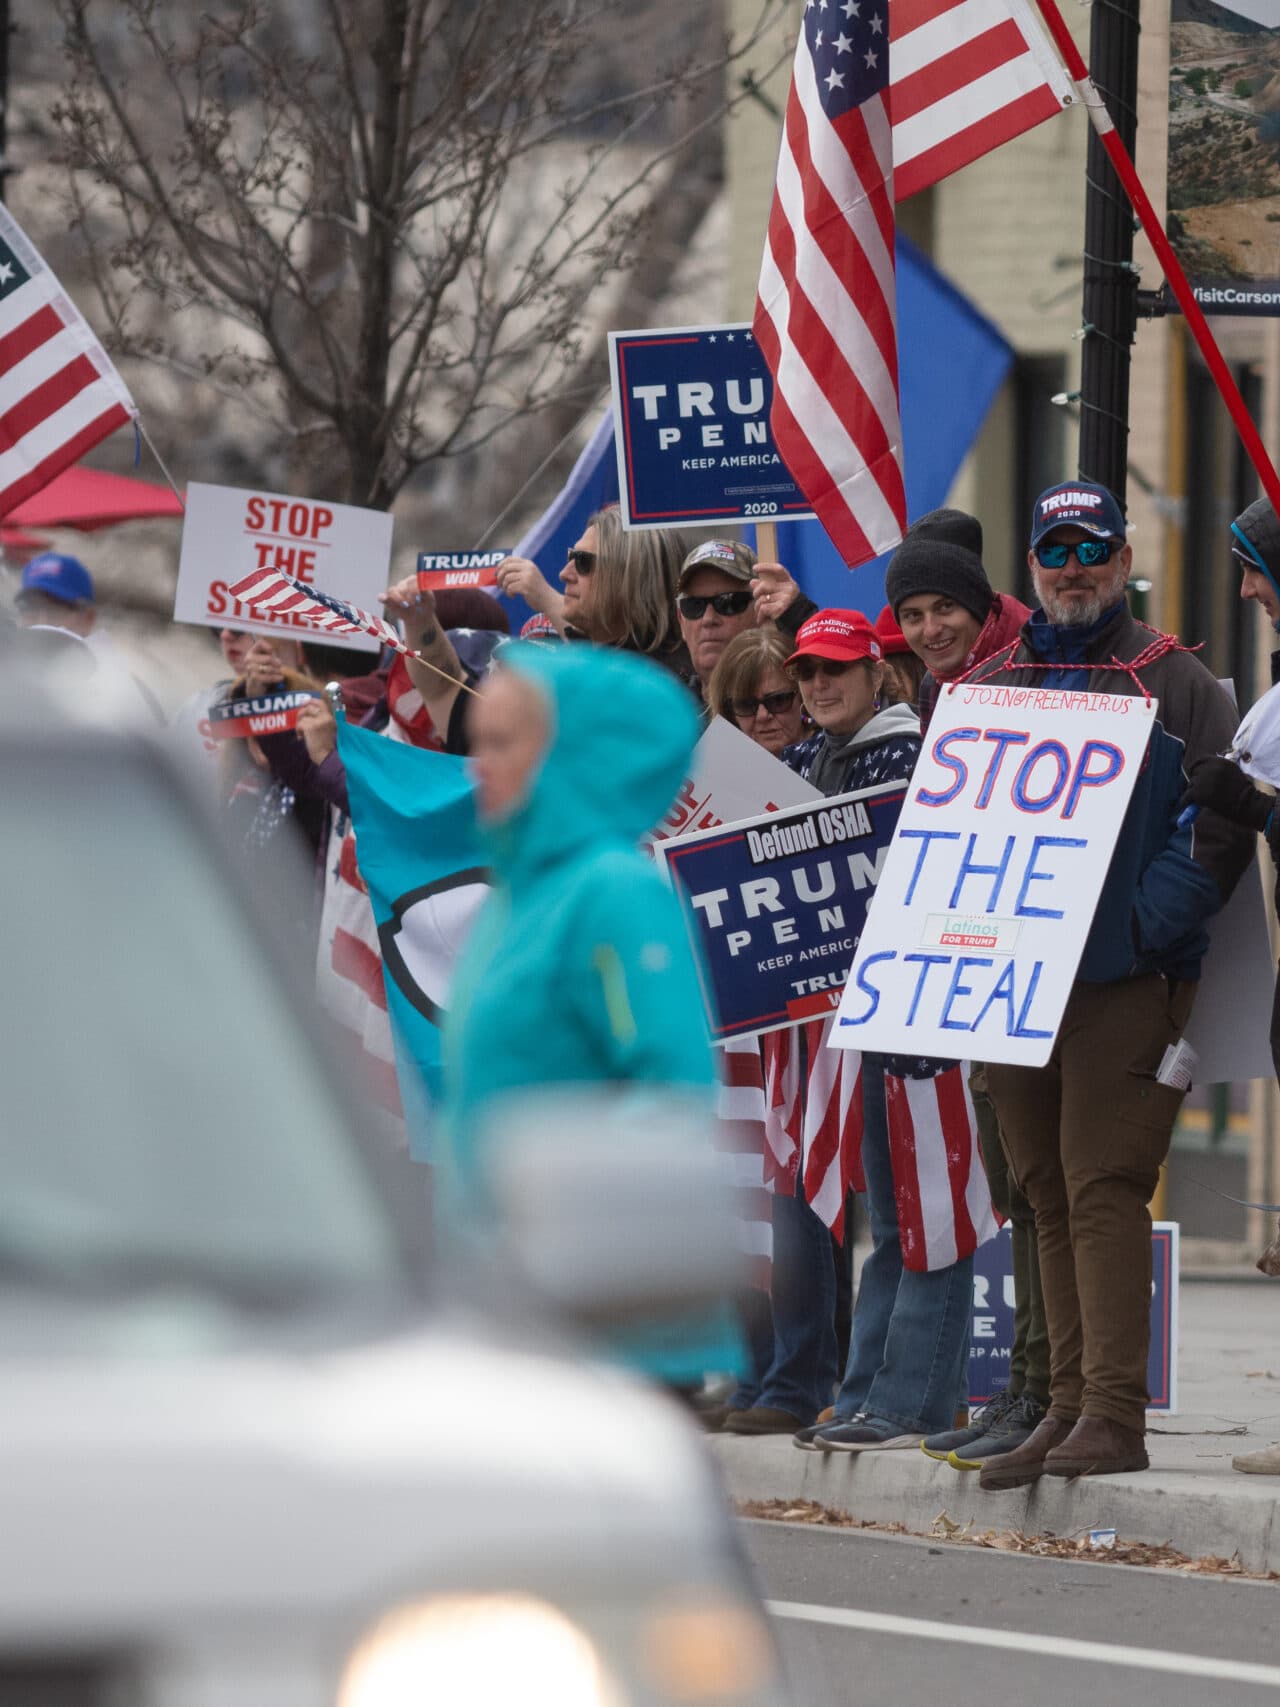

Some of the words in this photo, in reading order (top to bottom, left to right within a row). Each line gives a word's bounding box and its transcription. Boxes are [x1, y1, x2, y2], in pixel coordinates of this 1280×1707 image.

[632, 378, 764, 420] TRU
[658, 421, 768, 451] PEN
[682, 458, 716, 470] KEEP
[720, 453, 781, 468] AMERICA
[744, 502, 778, 516] 2020
[1041, 491, 1102, 515] TRUMP
[1057, 510, 1081, 519] 2020
[245, 496, 334, 539] STOP
[254, 542, 316, 584] THE
[423, 552, 505, 569] TRUMP
[445, 572, 480, 586] WON
[217, 692, 313, 718] TRUMP
[249, 714, 288, 732] WON
[915, 727, 1126, 820] STOP
[746, 815, 815, 864] Defund
[817, 801, 873, 846] OSHA
[690, 845, 891, 929] TRUM
[899, 829, 1088, 919] THE
[726, 897, 873, 957] PEN
[943, 917, 999, 936] Latinos
[942, 935, 961, 945] FOR
[963, 936, 995, 946] TRUMP
[756, 954, 793, 973] KEEP
[791, 968, 850, 996] TRU
[839, 950, 1054, 1038] STEAL
